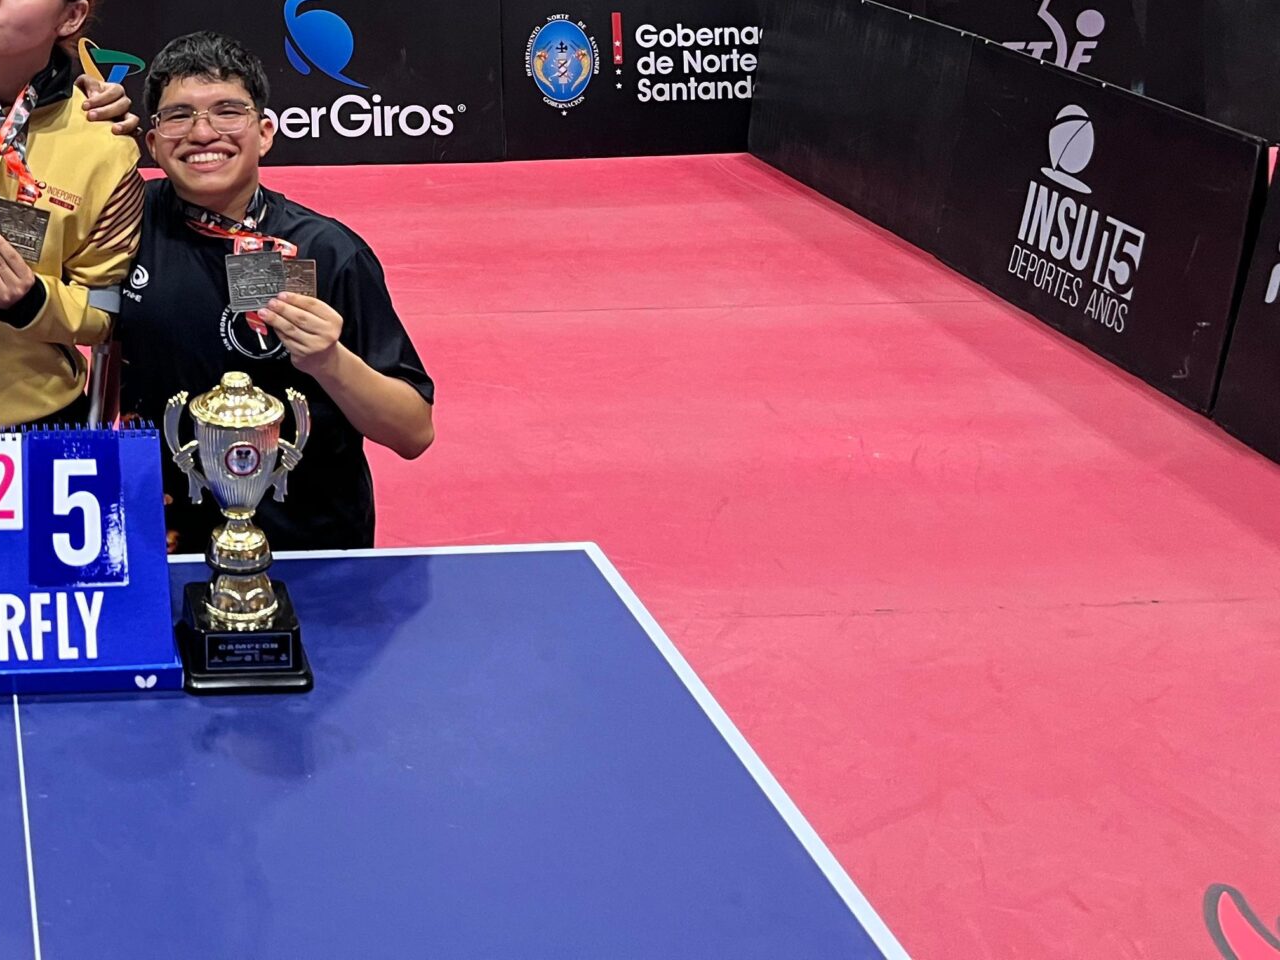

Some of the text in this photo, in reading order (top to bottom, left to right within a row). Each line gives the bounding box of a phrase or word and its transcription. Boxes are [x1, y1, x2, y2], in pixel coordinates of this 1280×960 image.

[546, 14, 570, 22] NORTE
[636, 49, 758, 76] de Norte
[637, 75, 756, 103] Santand
[1018, 180, 1099, 271] INSU
[1007, 244, 1128, 333] DEPORTES AÑOS
[220, 304, 232, 337] FRONTE
[52, 459, 102, 567] 5
